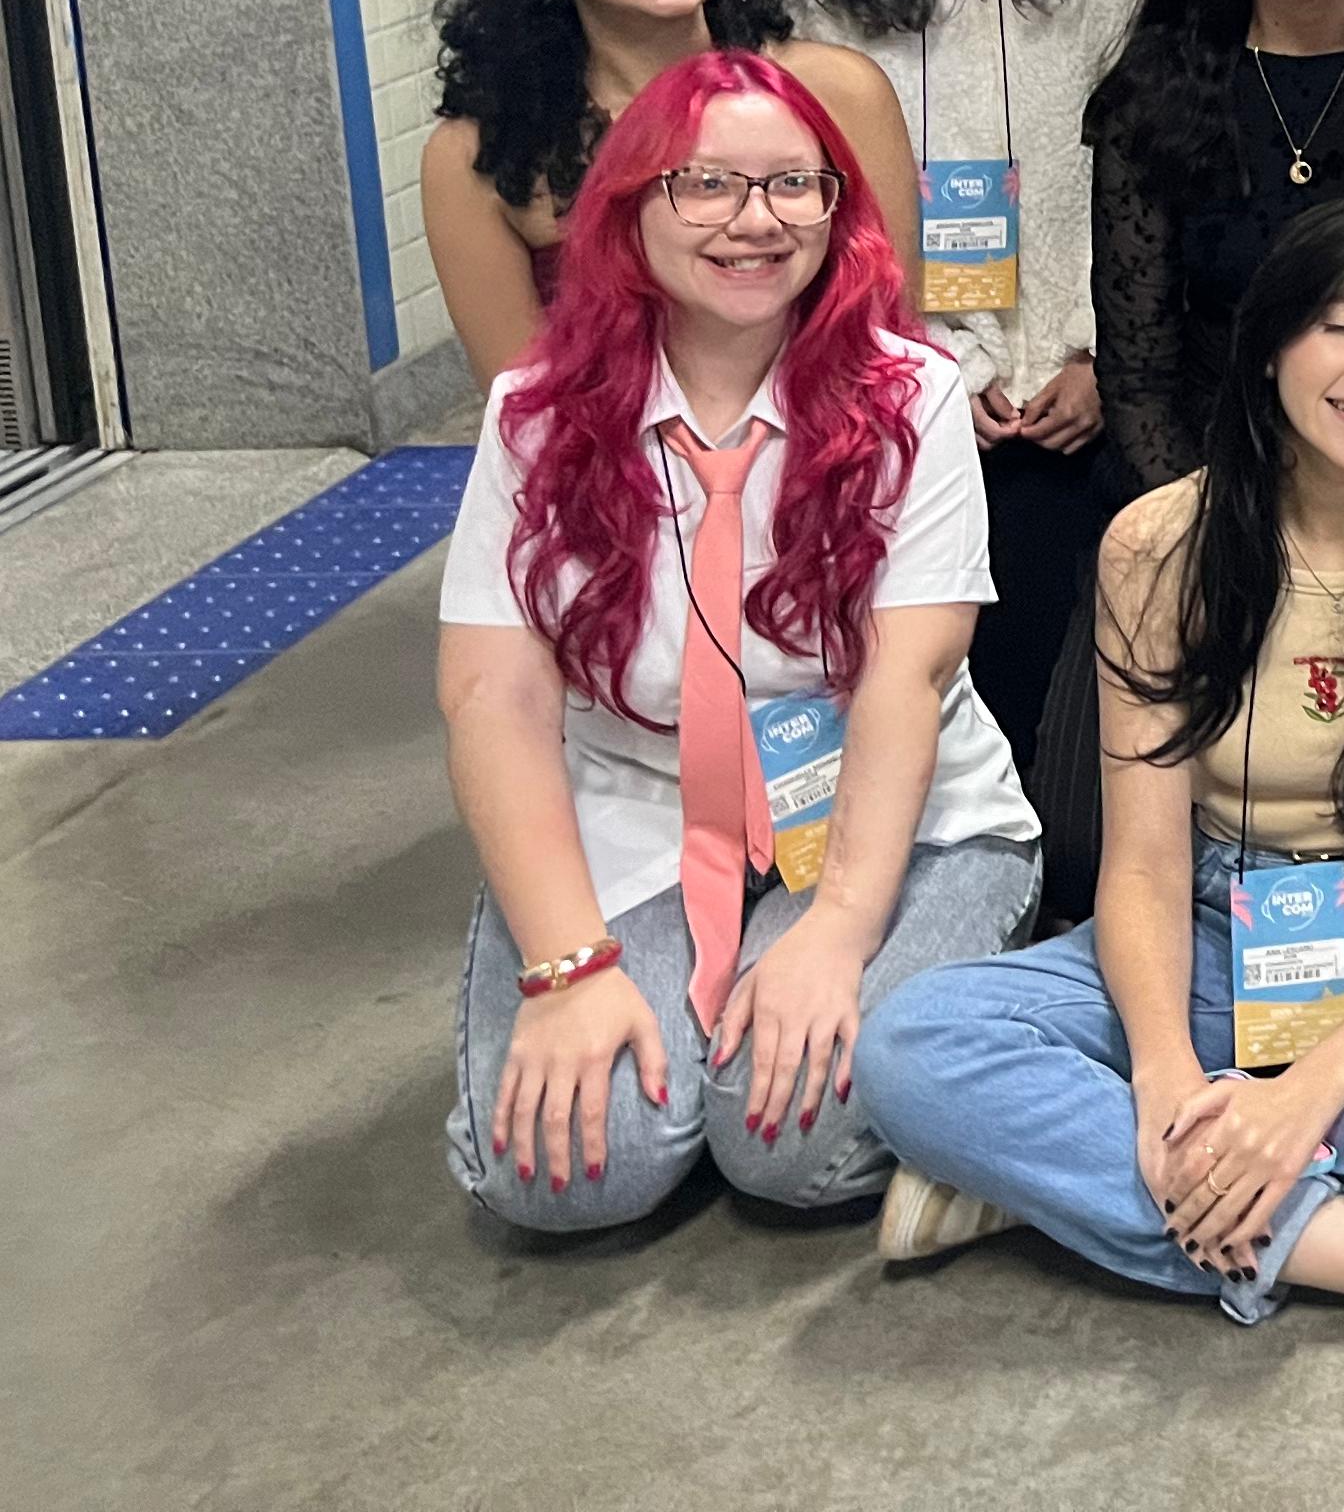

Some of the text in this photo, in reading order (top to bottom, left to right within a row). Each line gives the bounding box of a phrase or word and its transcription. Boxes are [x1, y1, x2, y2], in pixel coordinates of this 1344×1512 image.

[767, 713, 809, 738] INTER
[782, 721, 814, 744] COM
[1271, 891, 1313, 906] INTER
[1281, 903, 1314, 917] COM
